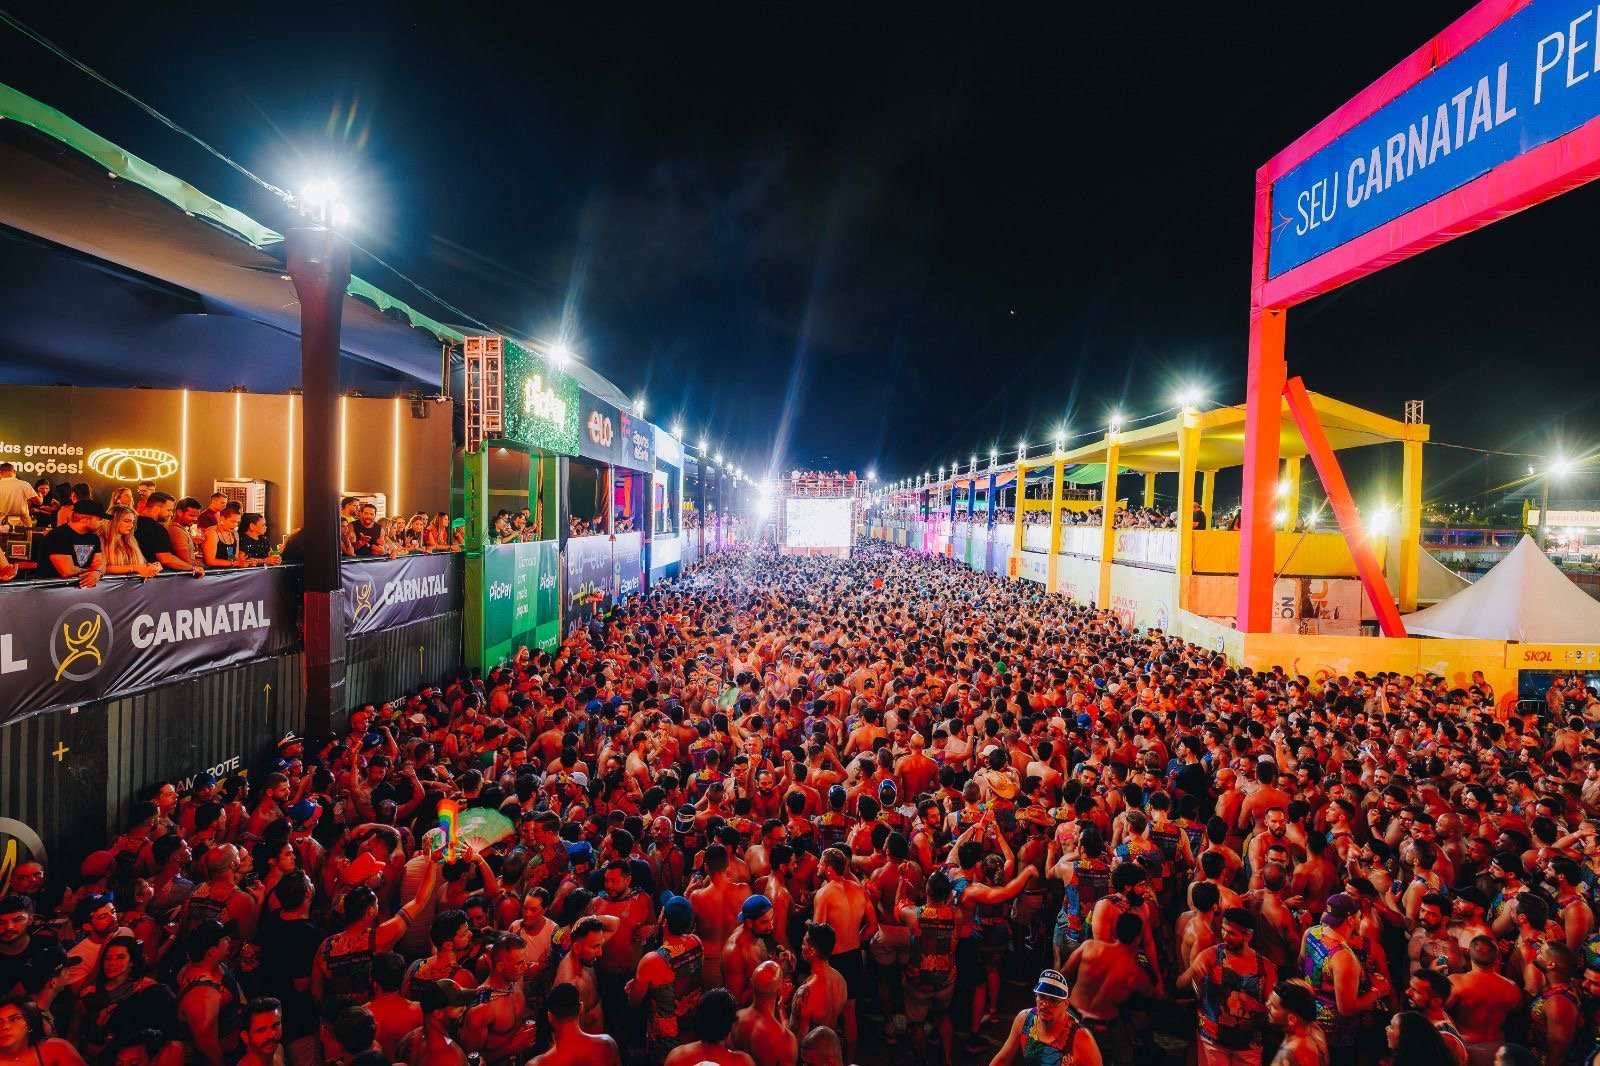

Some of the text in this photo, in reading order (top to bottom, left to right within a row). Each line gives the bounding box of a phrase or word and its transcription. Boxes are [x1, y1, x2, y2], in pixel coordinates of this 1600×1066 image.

[1296, 171, 1339, 236] SEU
[1346, 62, 1517, 209] CARNATAL
[24, 443, 83, 456] grandes
[384, 573, 449, 606] CARNATAL
[489, 580, 512, 602] PicPay
[131, 600, 271, 649] CARNATAL
[1523, 650, 1553, 663] SKOL
